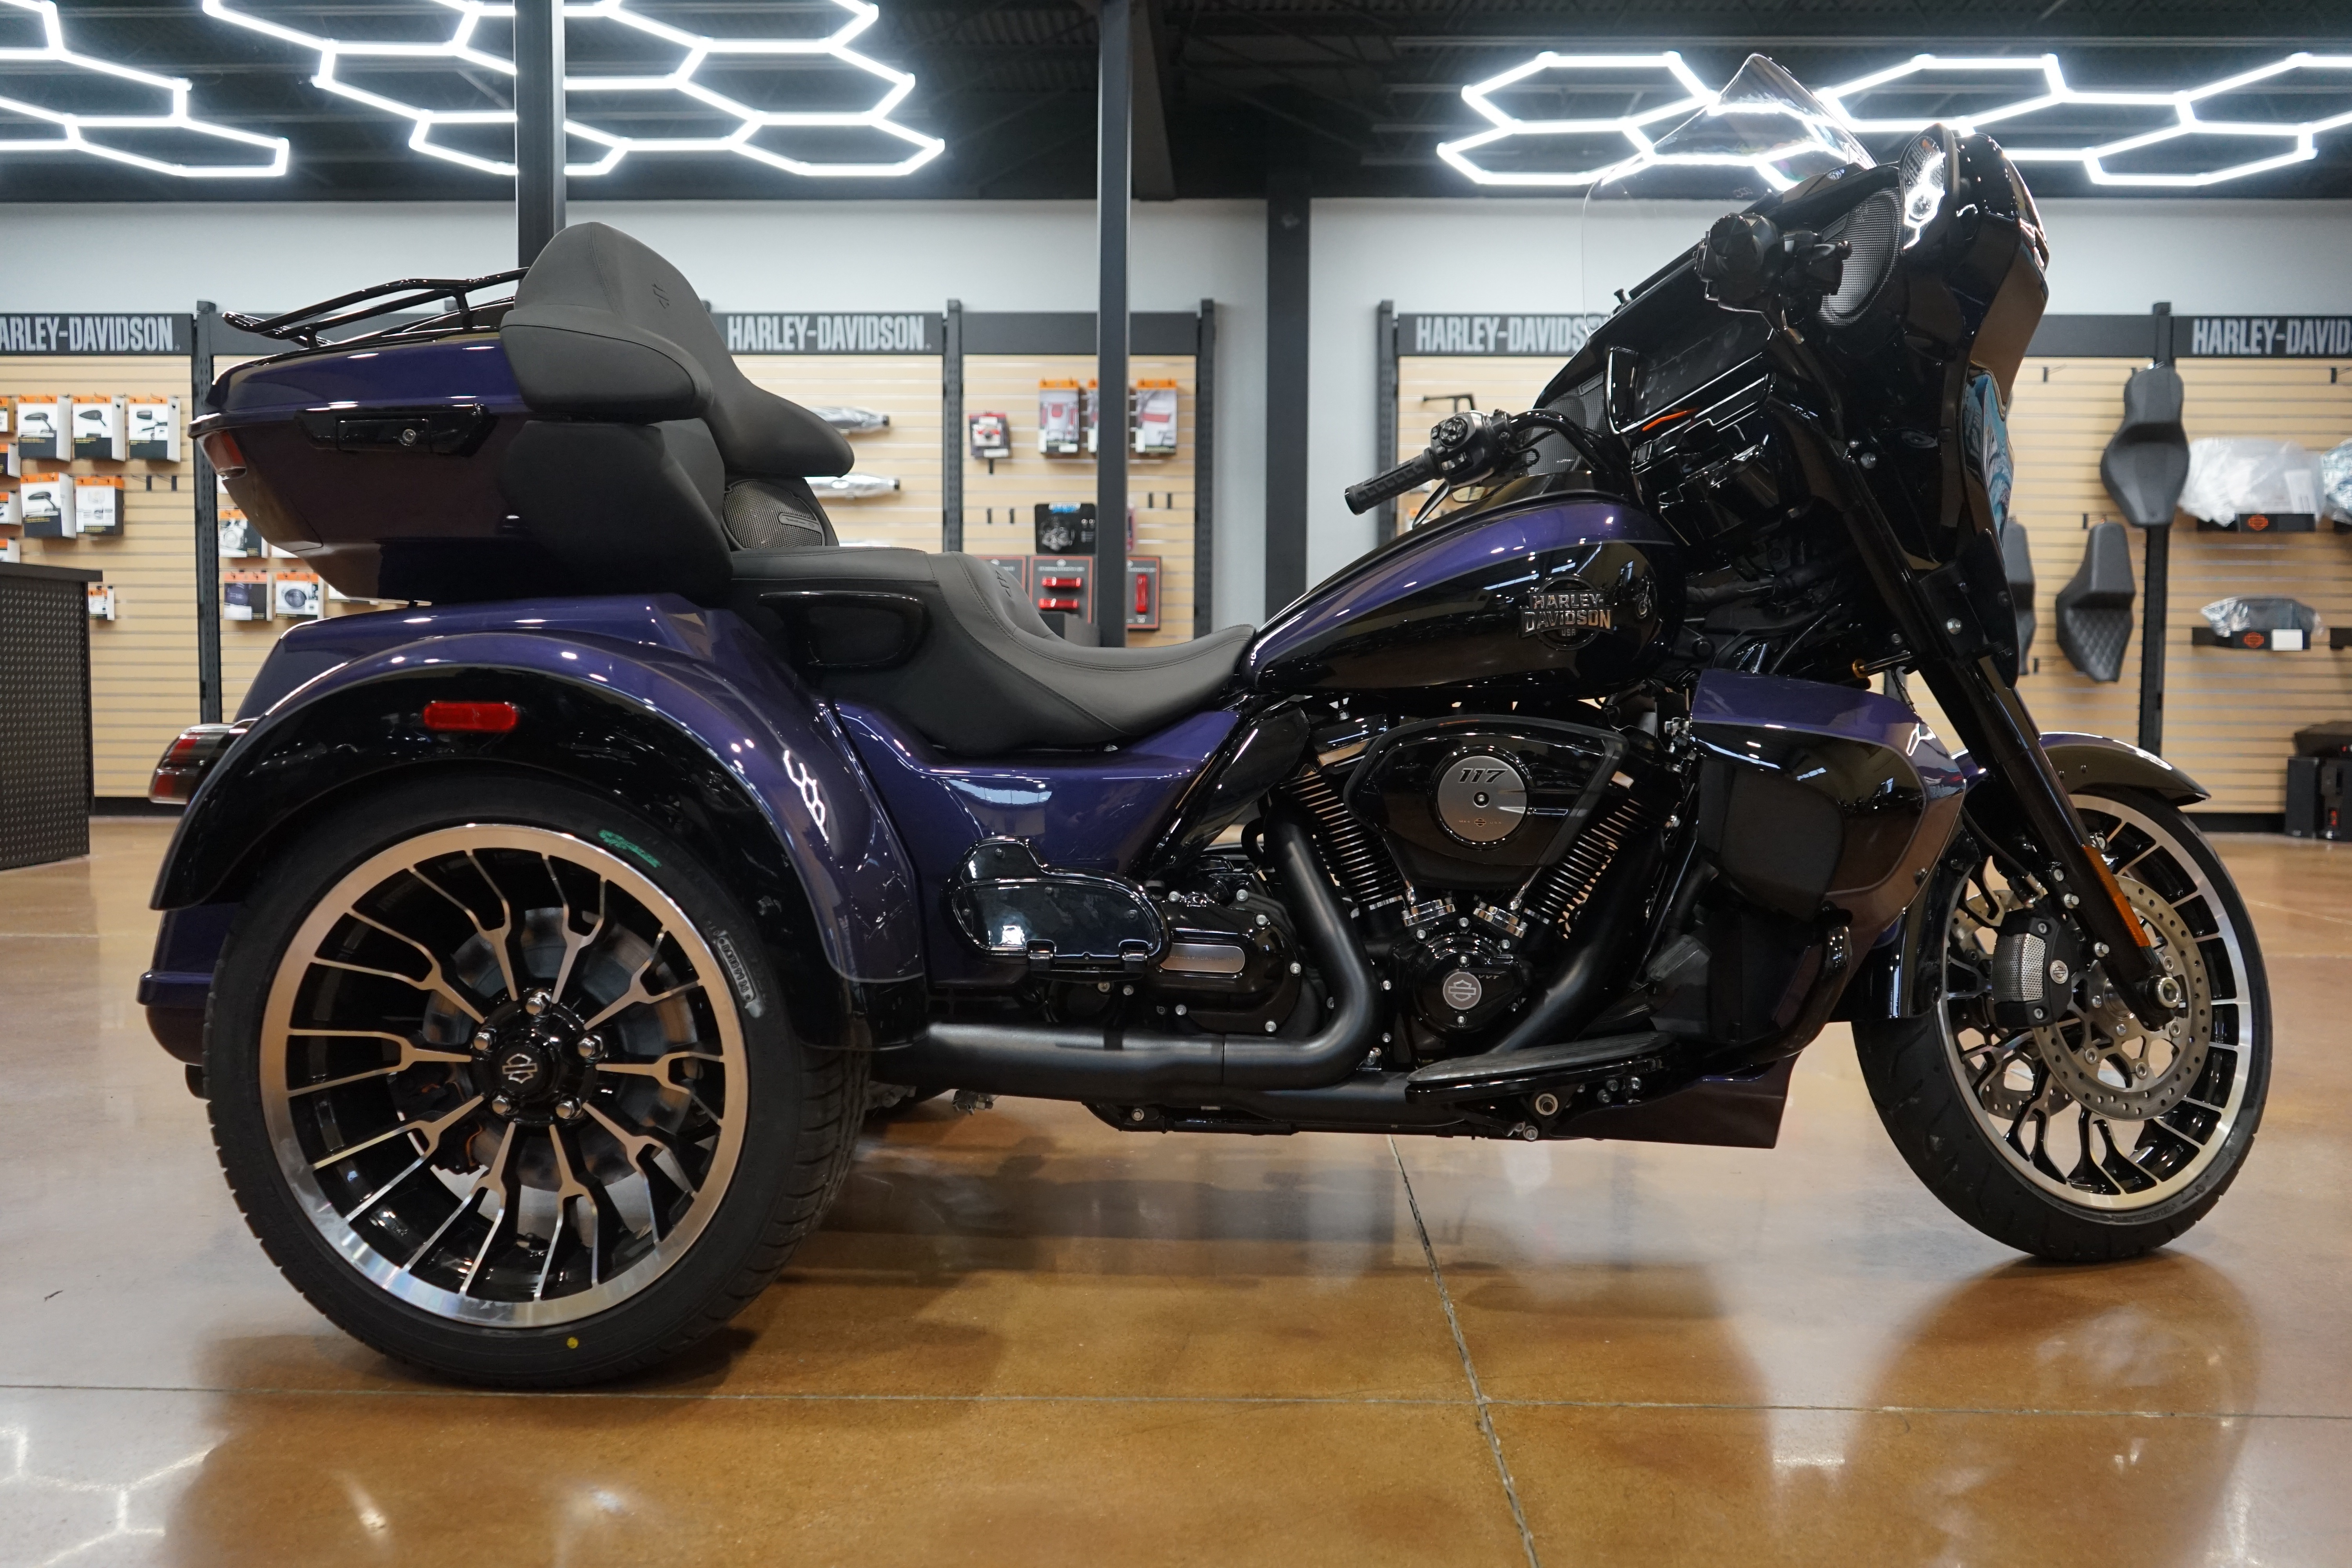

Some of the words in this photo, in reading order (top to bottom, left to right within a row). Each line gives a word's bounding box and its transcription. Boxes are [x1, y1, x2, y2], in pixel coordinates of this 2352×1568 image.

[727, 315, 924, 351] HARLEY-DAVIDSON
[1416, 316, 1608, 352] HARLEY-DAVIDS
[2192, 318, 2352, 354] HARLEY-DAVID
[1533, 593, 1604, 609] HARLEY-
[1524, 610, 1611, 632] DAVIDSON
[1458, 768, 1508, 784] 117
